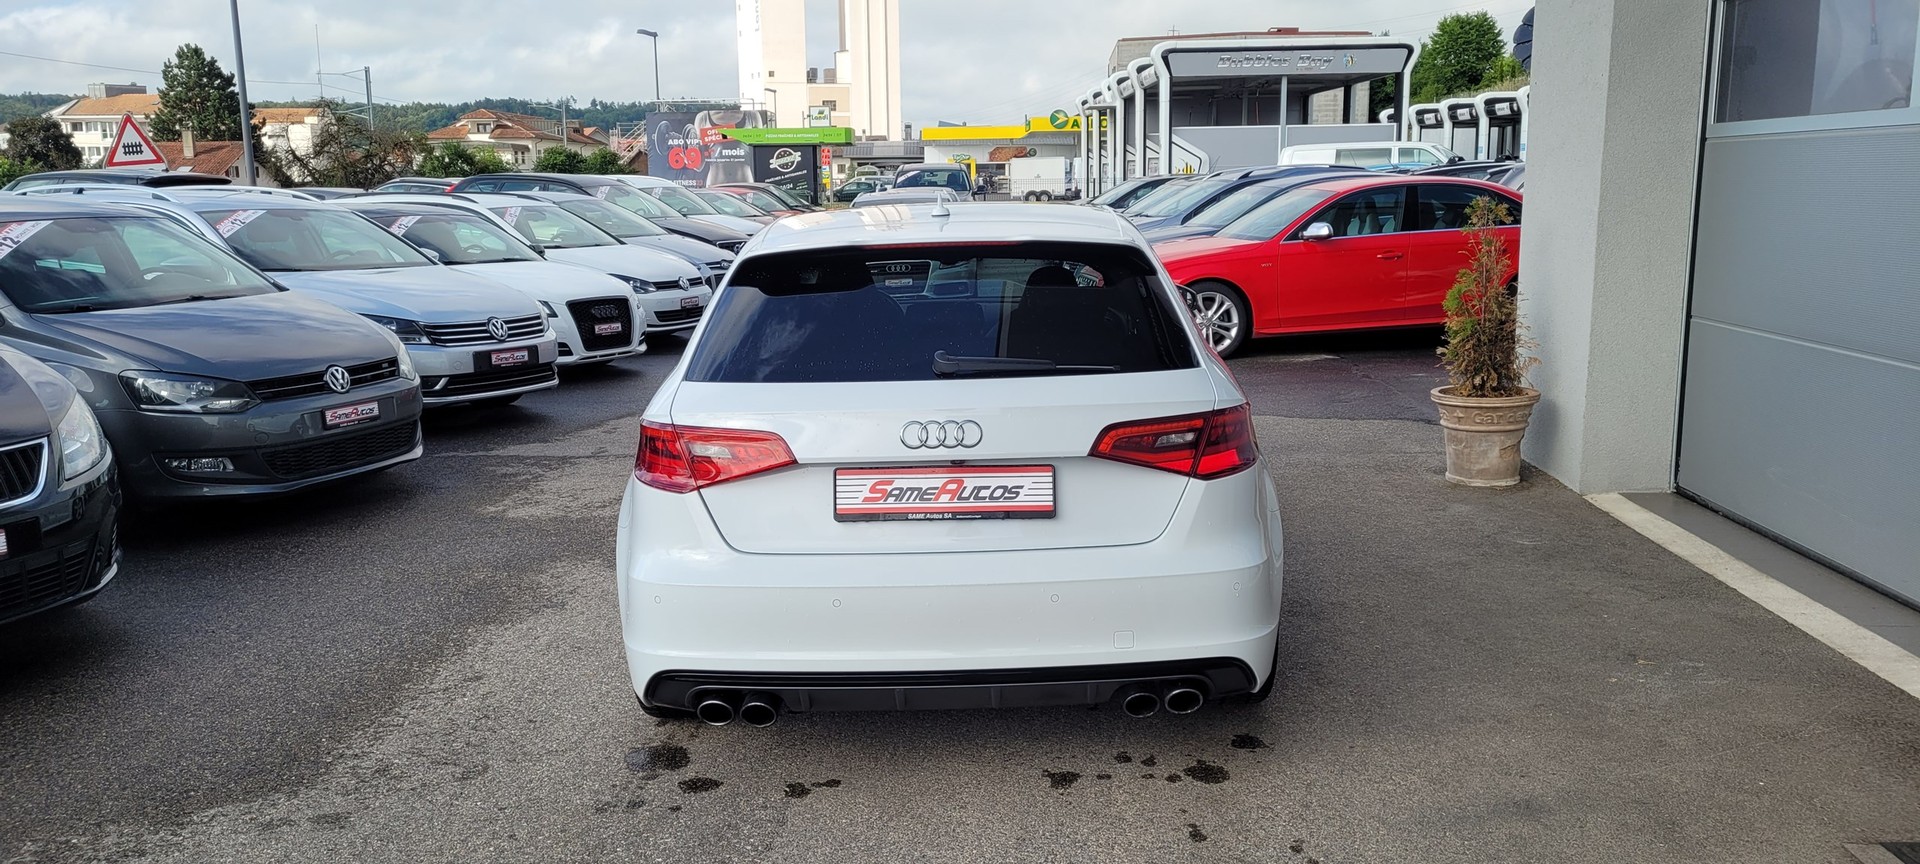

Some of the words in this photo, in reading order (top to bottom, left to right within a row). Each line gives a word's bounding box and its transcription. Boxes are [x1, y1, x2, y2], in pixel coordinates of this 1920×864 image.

[1217, 54, 1291, 68] Bubbles
[1297, 54, 1334, 69] Bay
[722, 147, 745, 156] mois
[668, 147, 702, 170] 69
[231, 218, 246, 227] 12
[0, 236, 21, 249] 12
